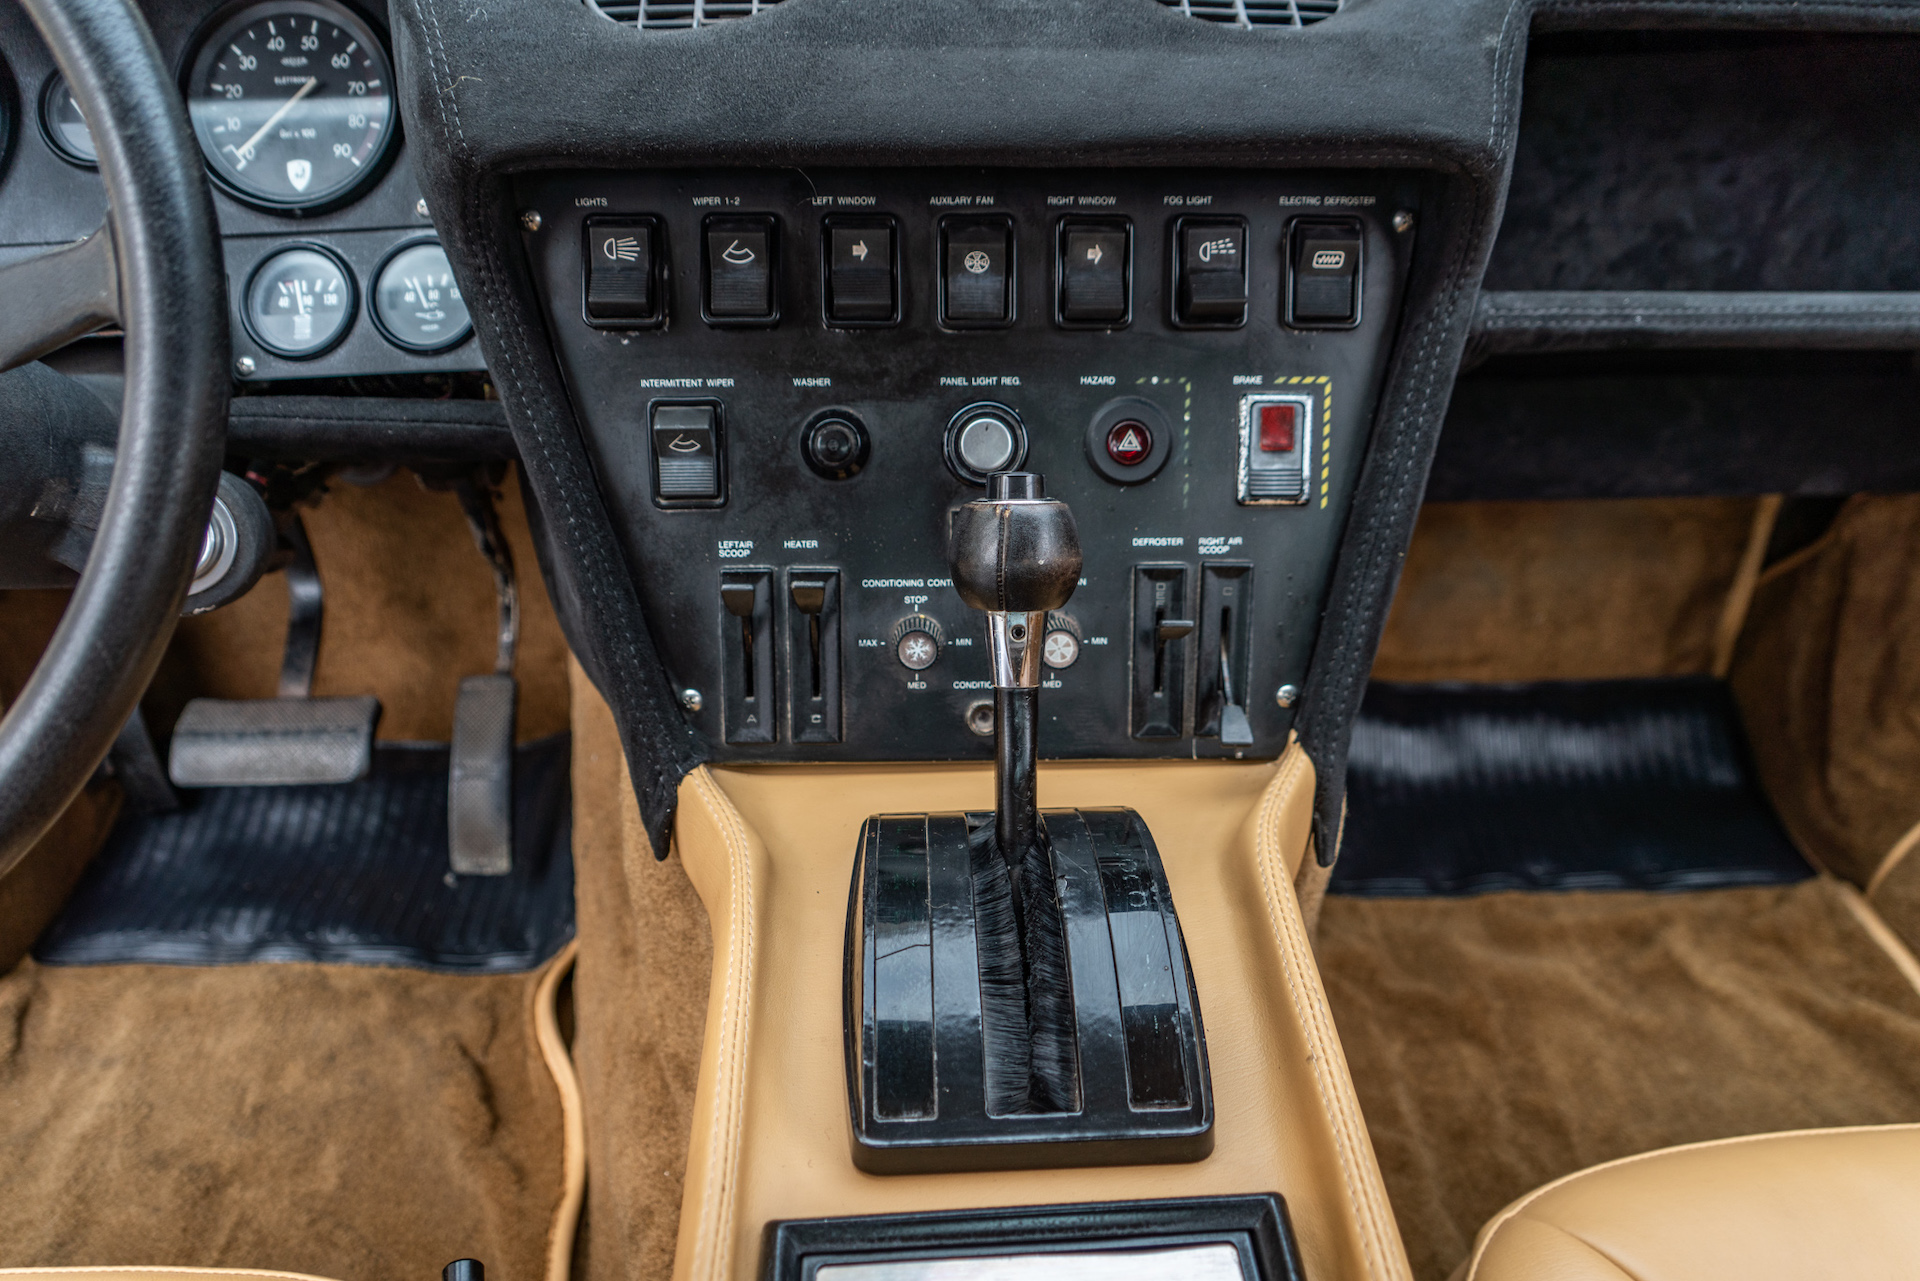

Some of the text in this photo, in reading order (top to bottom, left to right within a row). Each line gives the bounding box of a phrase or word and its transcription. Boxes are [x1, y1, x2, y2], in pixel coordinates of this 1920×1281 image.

[266, 36, 286, 51] 40
[300, 35, 320, 51] 50
[238, 55, 258, 71] 30
[331, 53, 350, 69] 60
[225, 83, 244, 99] 20
[347, 81, 366, 96] 70
[226, 116, 241, 132] 10
[348, 114, 366, 129] 80
[333, 143, 352, 158] 90
[575, 197, 608, 207] LIGHTS
[692, 197, 721, 206] WIPER
[811, 195, 877, 205] LEFT WINDOW
[929, 196, 994, 206] AUXILARY FAN
[1047, 196, 1117, 205] RIGHT WINDOW
[1163, 195, 1213, 206] FOG LIGHT
[1279, 196, 1376, 206] ELECTRIC DEFROSTER
[640, 378, 735, 388] INTERMITTENT WIPER
[792, 377, 832, 387] WASHER
[940, 376, 969, 387] PANEL
[971, 376, 998, 386] LIGHT
[1080, 375, 1116, 386] HAZARD
[1232, 375, 1263, 386] BRAKE
[783, 540, 819, 549] HEATER
[1132, 537, 1184, 546] DEFROSTER
[1198, 537, 1243, 545] RIGHT AIR
[718, 549, 751, 558] SCOOP
[1198, 545, 1230, 555] SCOOP
[861, 579, 954, 588] CONDITIONING CONT
[903, 595, 929, 605] STOP
[858, 640, 878, 648] MAX
[955, 638, 973, 647] MIN
[1090, 637, 1109, 646] MIN
[907, 681, 927, 690] MED
[1042, 681, 1062, 689] MED
